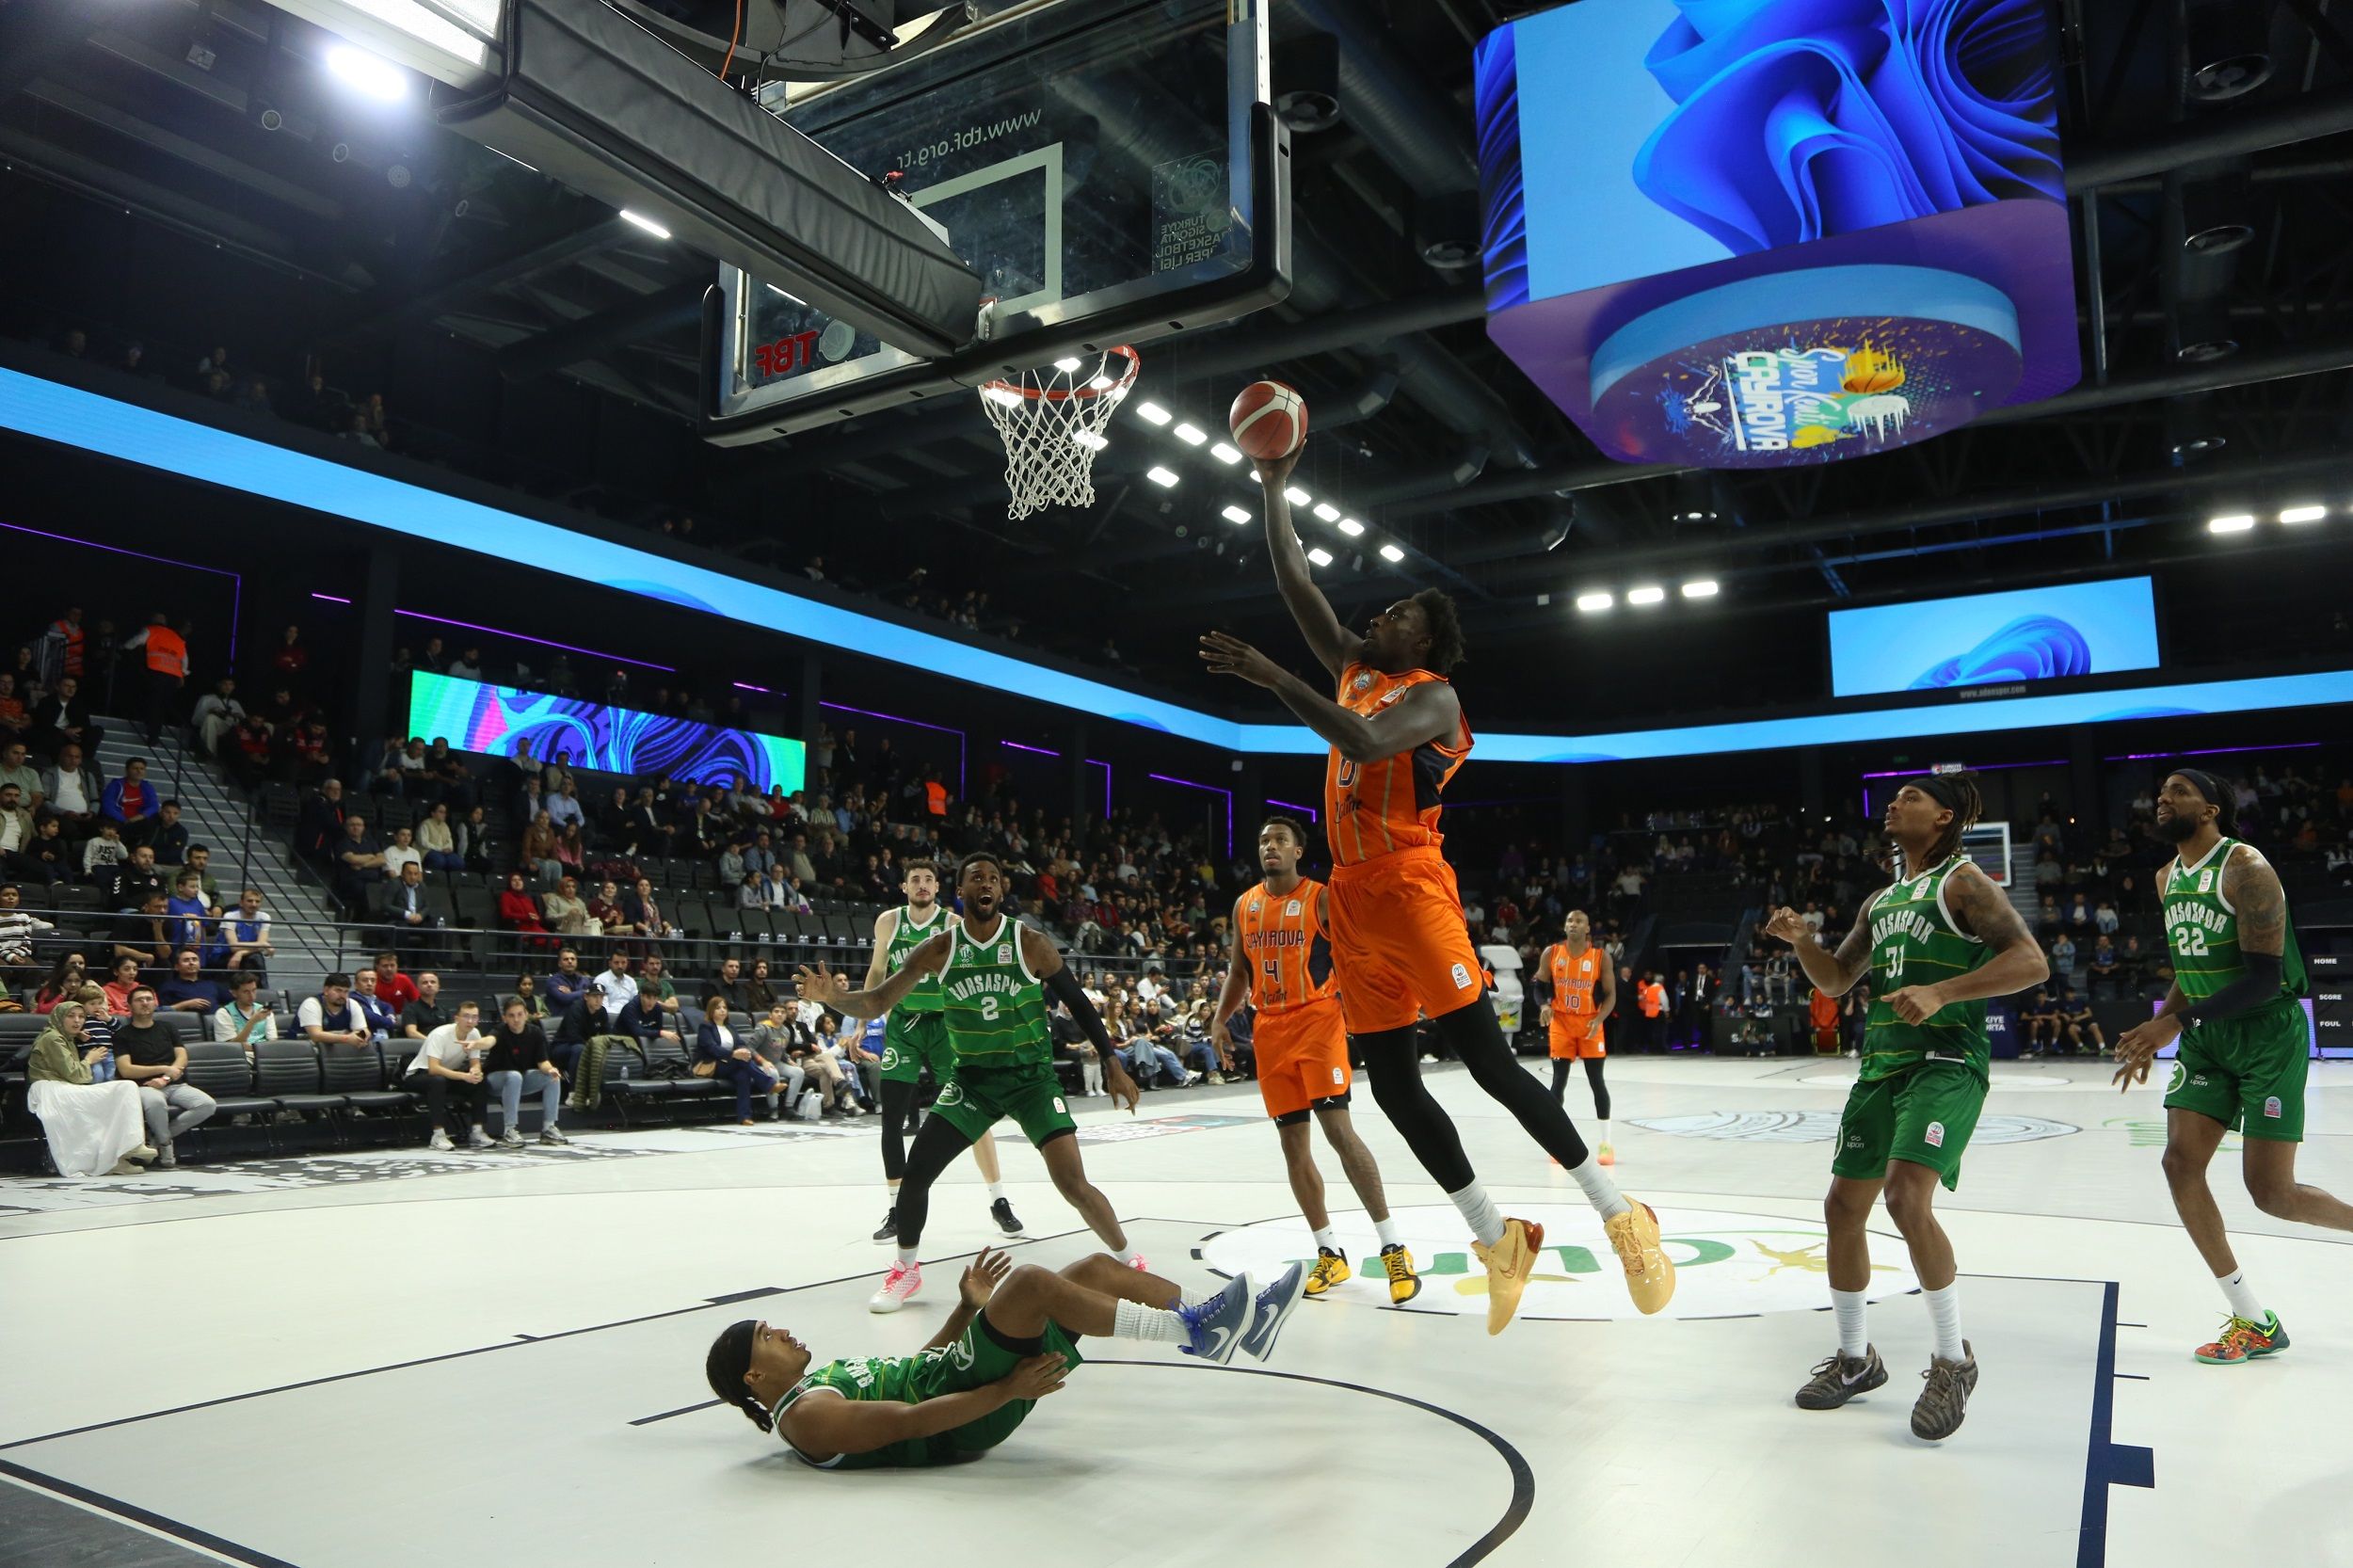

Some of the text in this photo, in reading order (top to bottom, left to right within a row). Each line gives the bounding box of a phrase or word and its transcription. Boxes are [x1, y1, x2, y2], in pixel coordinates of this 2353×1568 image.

[1727, 351, 1788, 451] ÇAYIROVA
[1872, 910, 1935, 952] URSASPOR
[2175, 927, 2209, 955] 22
[1264, 960, 1280, 984] 4
[1885, 944, 1904, 979] 31
[981, 996, 999, 1021] 2
[1566, 994, 1580, 1009] 10
[2190, 1079, 2208, 1087] upon
